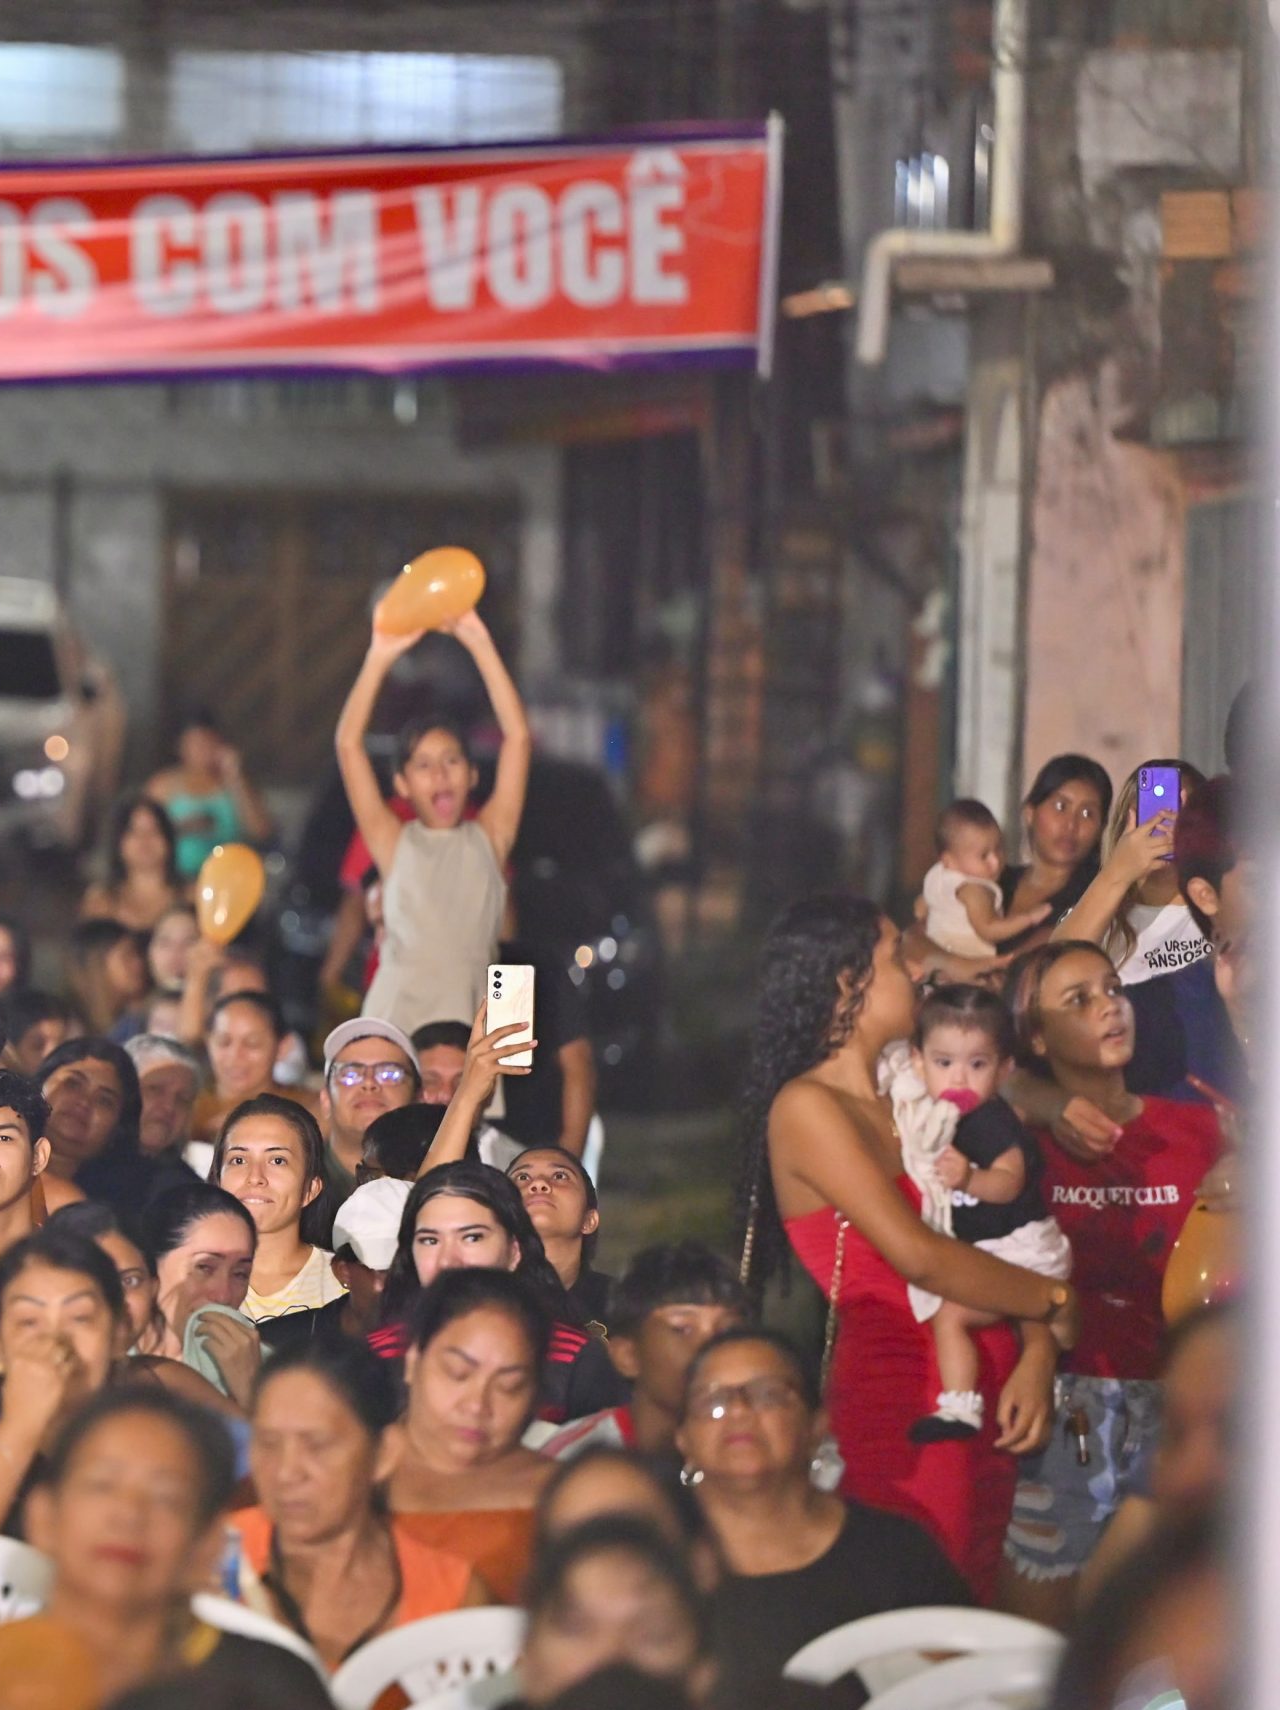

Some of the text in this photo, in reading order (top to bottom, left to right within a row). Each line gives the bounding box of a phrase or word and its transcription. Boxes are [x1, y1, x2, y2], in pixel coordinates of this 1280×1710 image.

[129, 189, 381, 316] COM
[414, 147, 689, 311] VOCÊ
[1052, 1184, 1180, 1210] RACQUET CLUB
